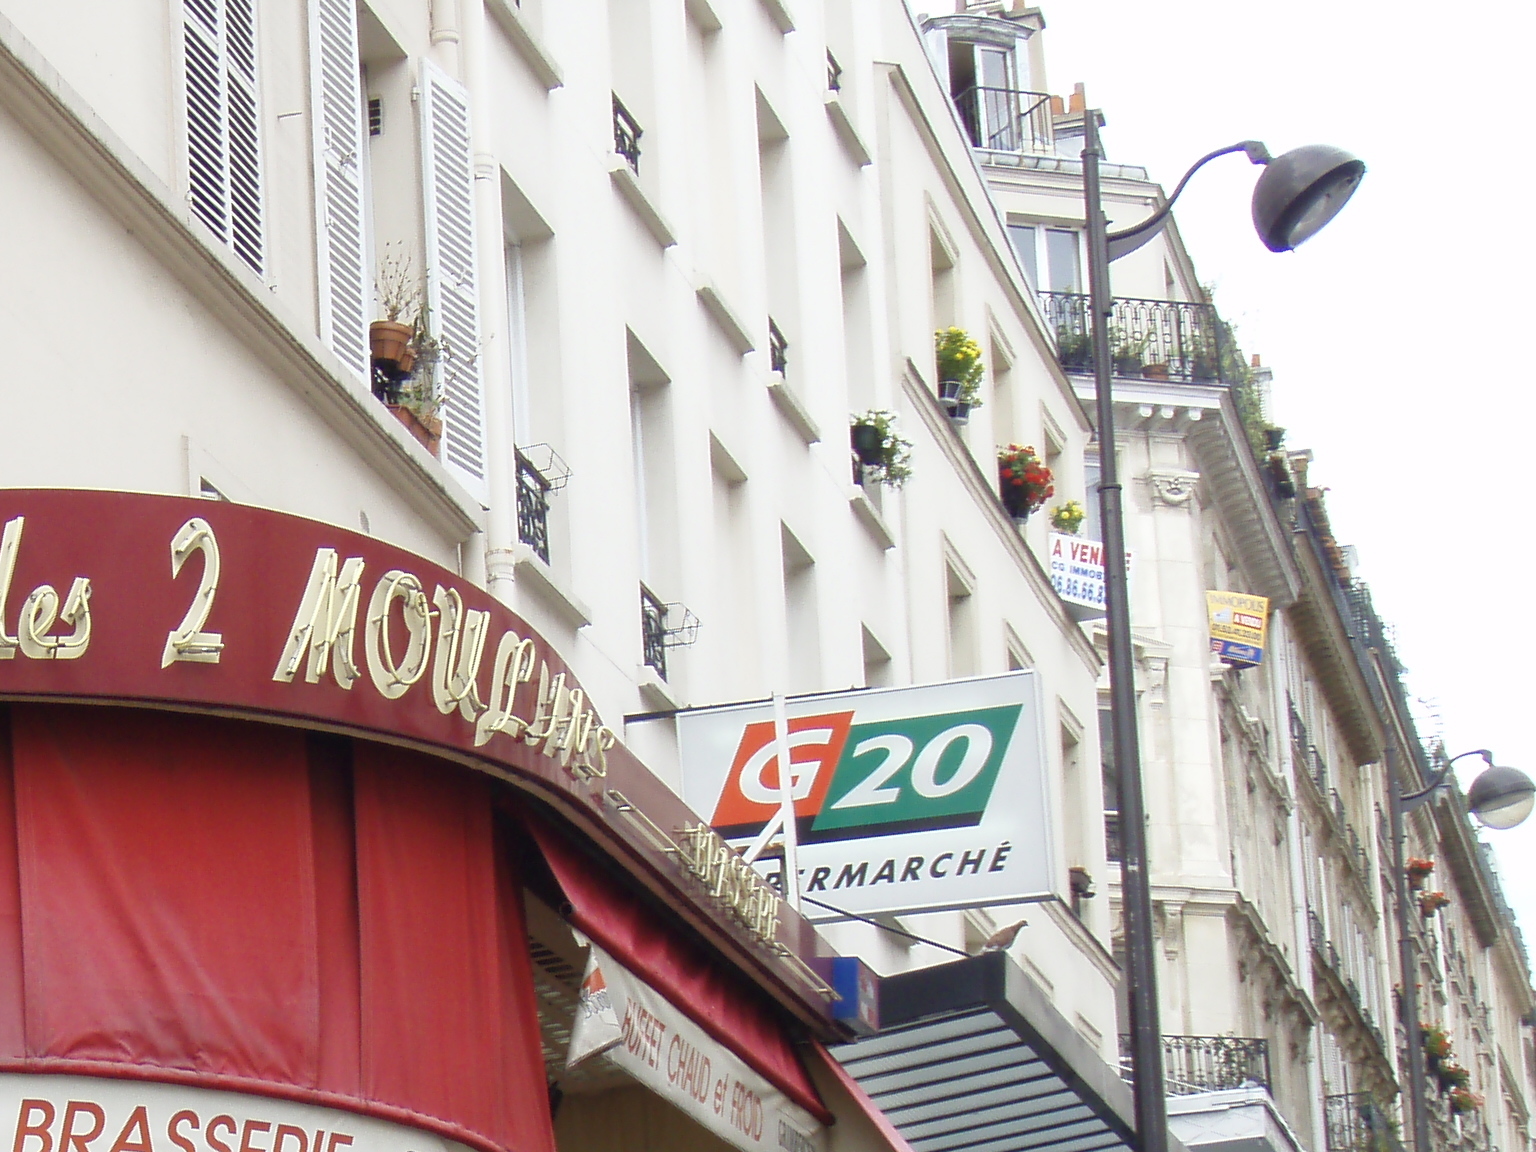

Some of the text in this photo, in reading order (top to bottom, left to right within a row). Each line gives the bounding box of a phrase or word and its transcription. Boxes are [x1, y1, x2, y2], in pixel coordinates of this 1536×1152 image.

[160, 517, 225, 669] 2
[271, 547, 615, 785] MOULINS
[739, 722, 992, 810] G20
[667, 1033, 711, 1104] CHAUD
[713, 1073, 728, 1118] et
[730, 1080, 764, 1142] FROID
